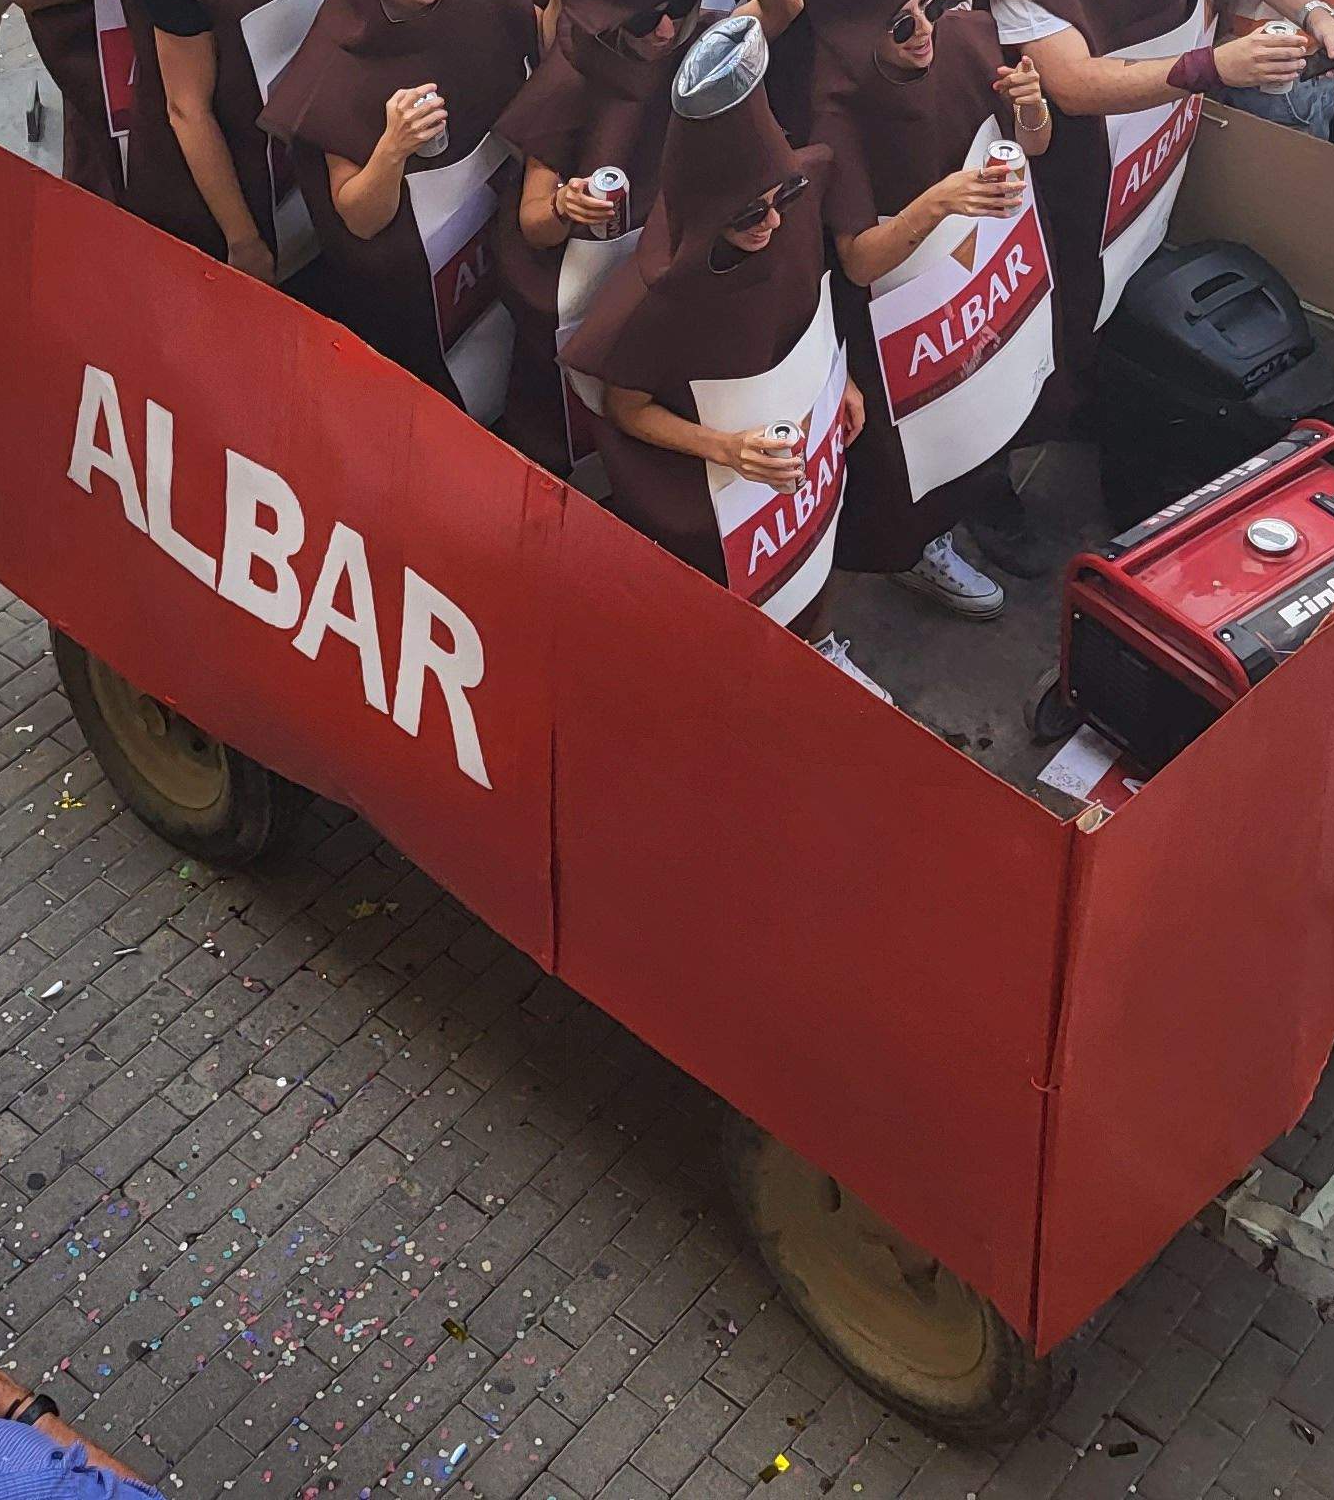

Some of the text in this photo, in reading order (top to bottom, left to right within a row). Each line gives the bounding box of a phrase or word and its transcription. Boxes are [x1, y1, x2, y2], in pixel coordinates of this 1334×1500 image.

[1120, 94, 1195, 207] ALBAR
[908, 243, 1033, 378] ALBAR
[747, 423, 846, 578] ALBAR
[67, 364, 492, 790] ALBAR
